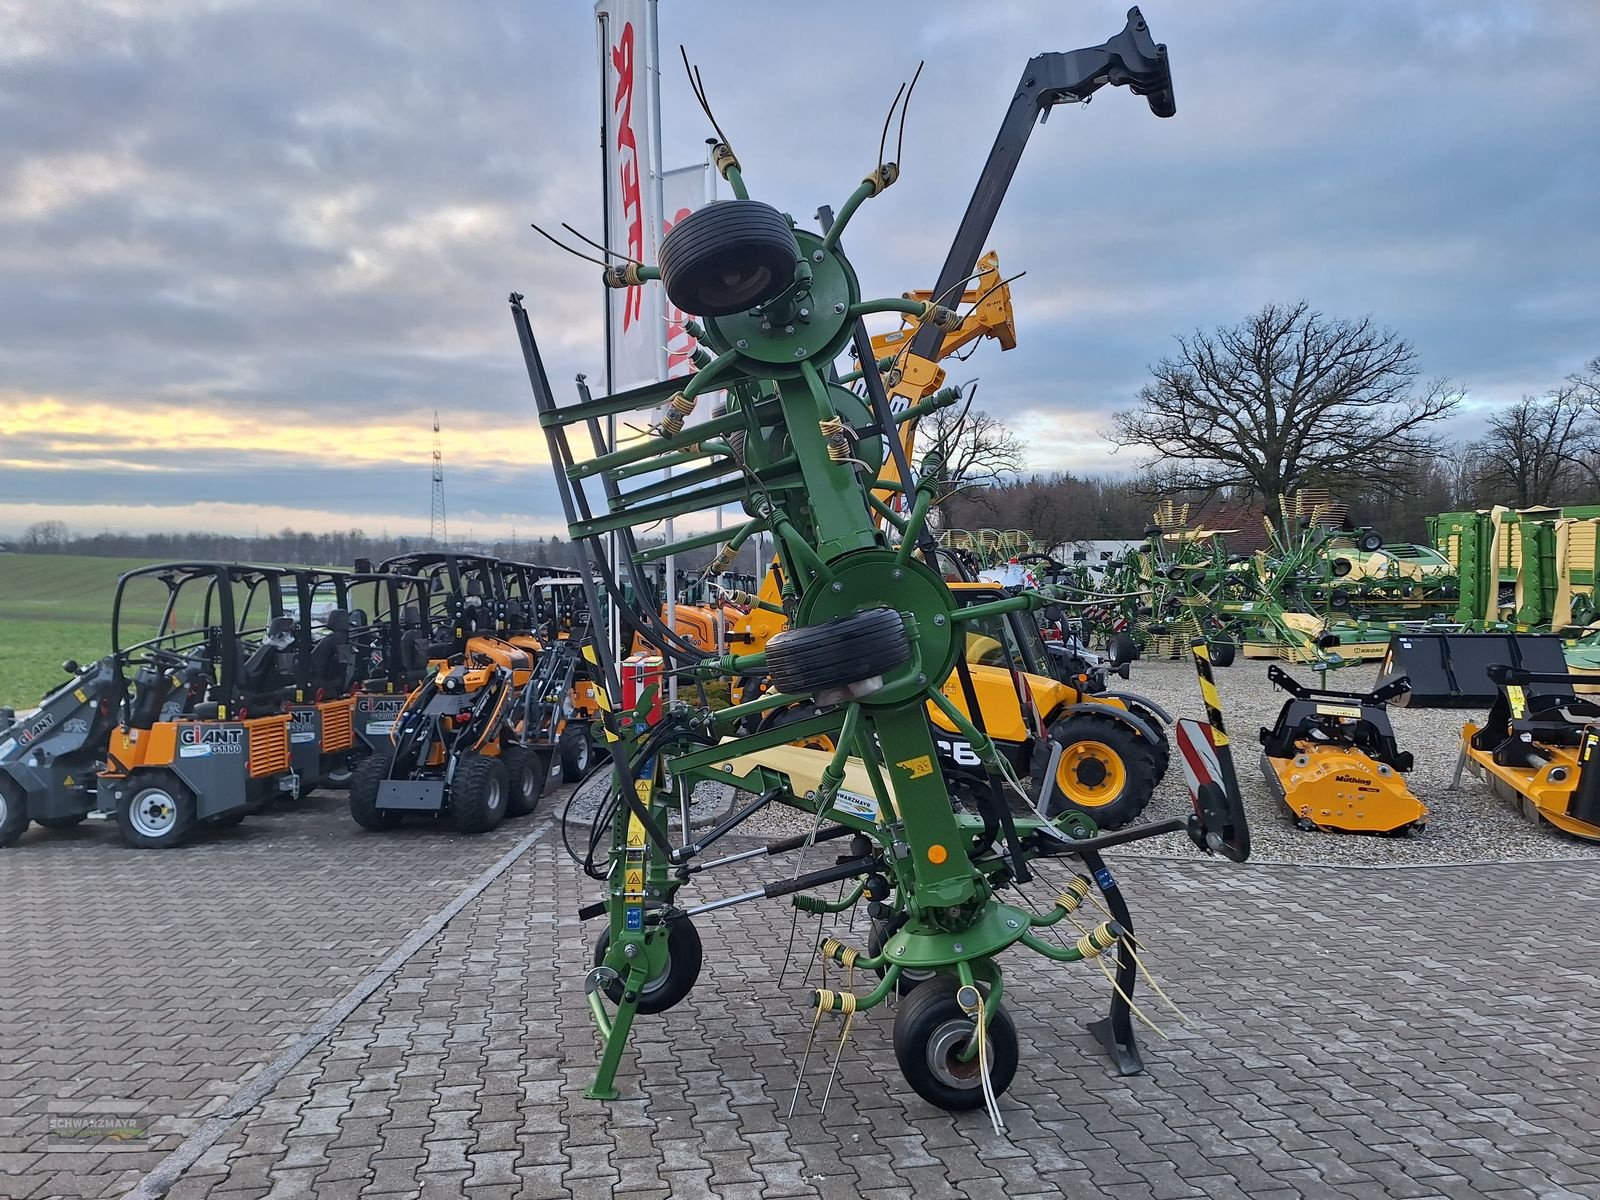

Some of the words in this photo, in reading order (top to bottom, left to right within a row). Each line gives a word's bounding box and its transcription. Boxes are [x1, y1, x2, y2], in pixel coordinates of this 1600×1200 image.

[359, 698, 404, 712] GIANT
[19, 713, 53, 745] GIANT
[181, 725, 242, 744] GIANT
[211, 744, 241, 754] G1100
[1335, 774, 1371, 785] Müthing
